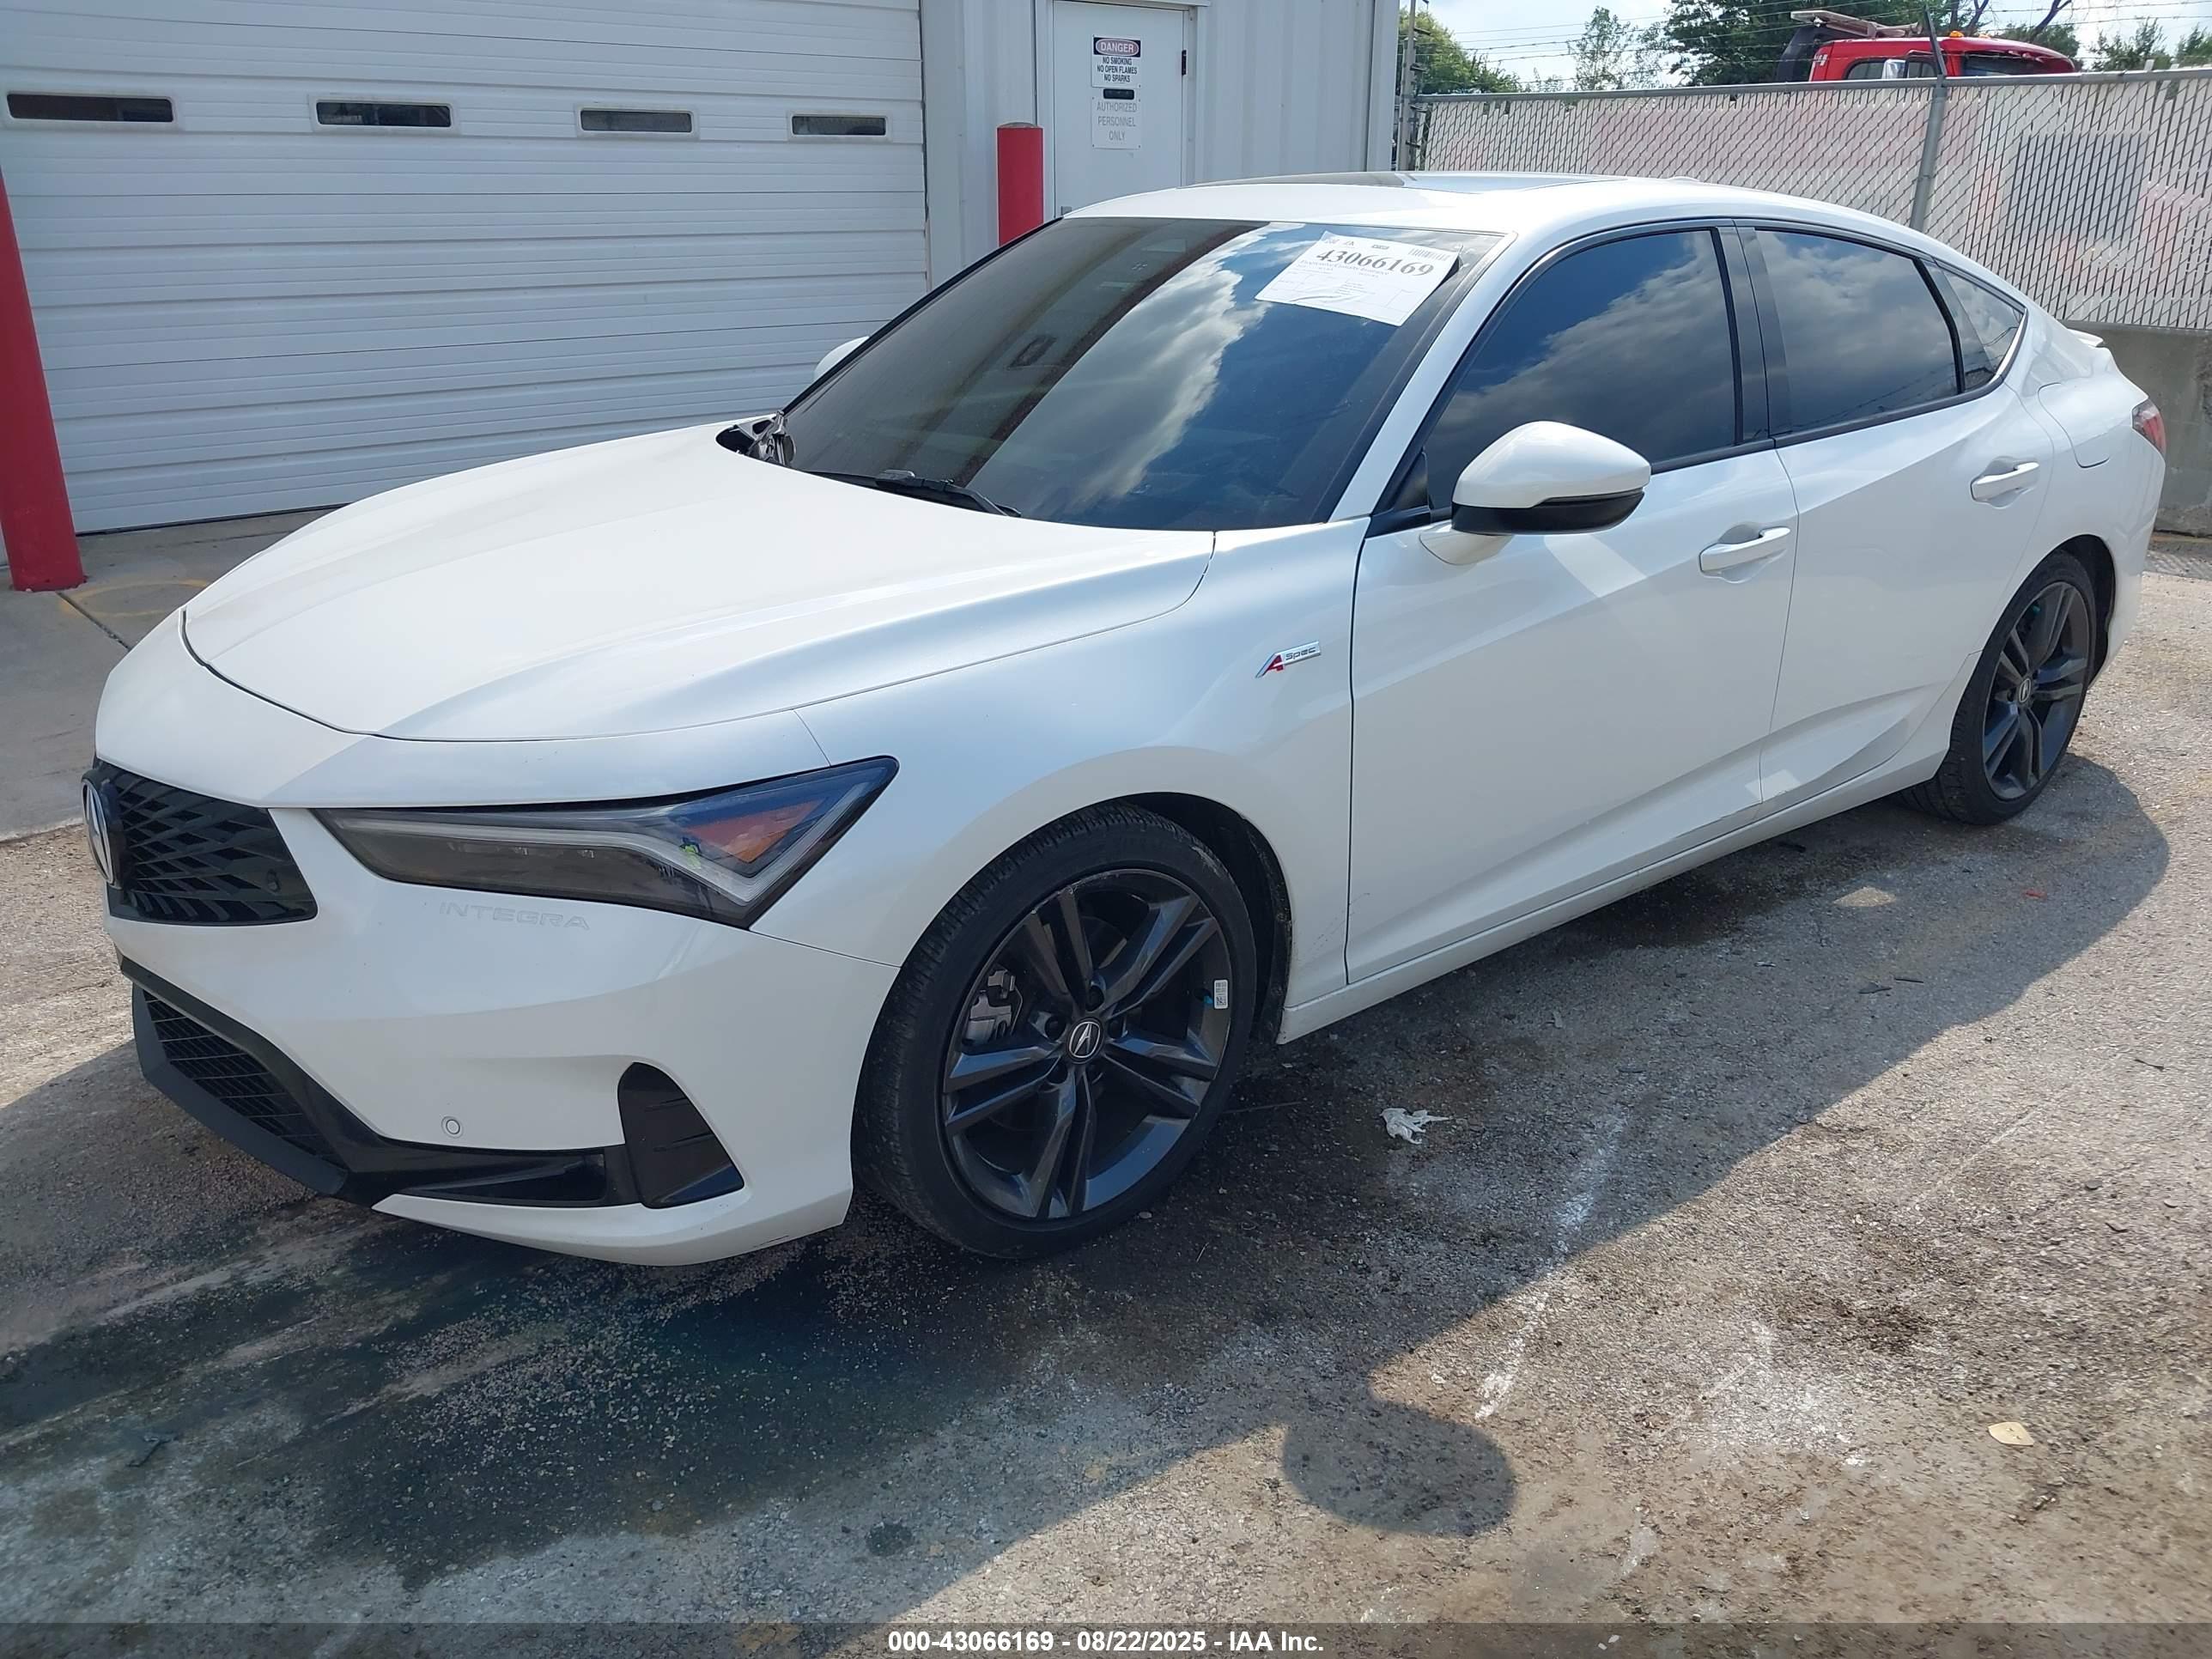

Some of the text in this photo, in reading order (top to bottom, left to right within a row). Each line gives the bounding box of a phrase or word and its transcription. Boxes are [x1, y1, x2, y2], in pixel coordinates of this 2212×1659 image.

[1100, 42, 1134, 52] DANGER
[1110, 57, 1132, 65] SMOKING
[1097, 101, 1137, 112] AUTHORIZED
[1097, 116, 1136, 127] PERSONNEL
[1109, 131, 1126, 141] ONLY
[1316, 249, 1435, 276] 43066169
[439, 901, 590, 931] INTEGRA
